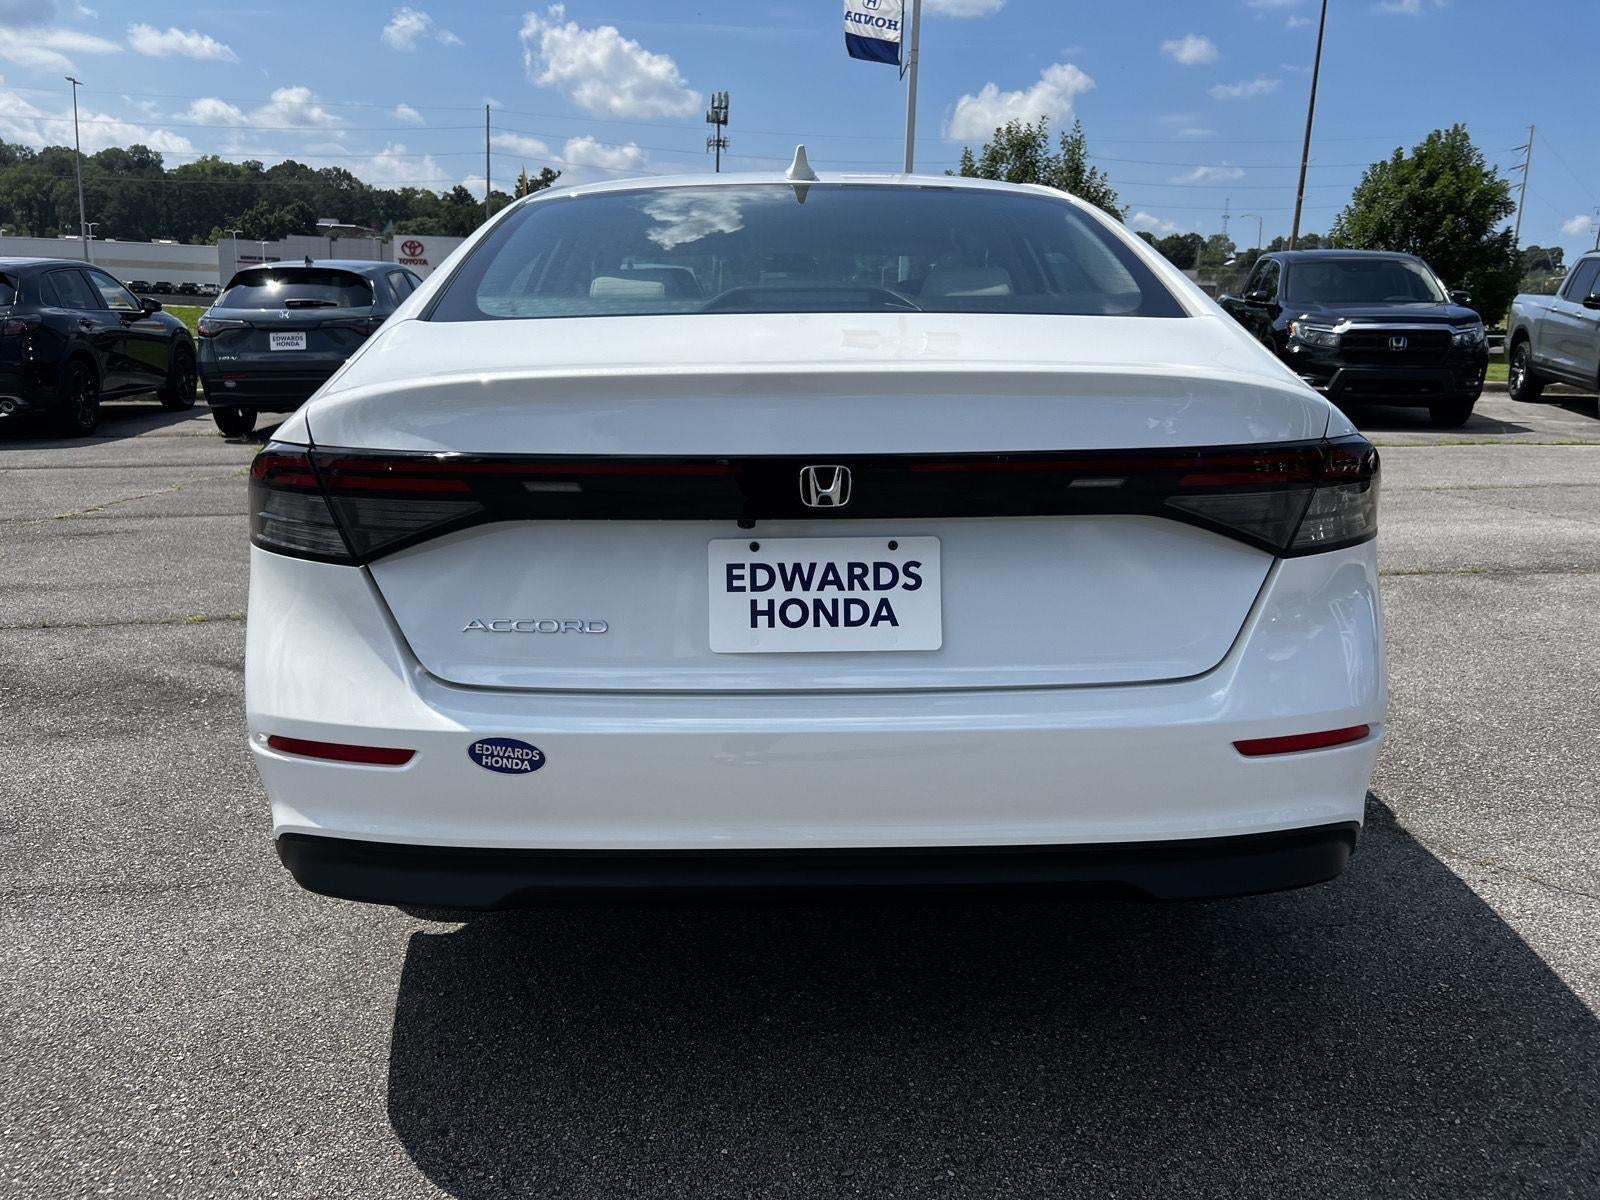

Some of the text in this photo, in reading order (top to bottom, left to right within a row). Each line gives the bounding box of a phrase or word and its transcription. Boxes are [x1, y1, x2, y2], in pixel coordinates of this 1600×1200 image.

[398, 257, 428, 265] TOYOTA
[726, 561, 923, 592] EDWARDS
[750, 597, 899, 628] HONDA
[462, 618, 609, 633] ACCORD
[475, 743, 540, 760] EDWARDS
[481, 755, 531, 771] HONDA
